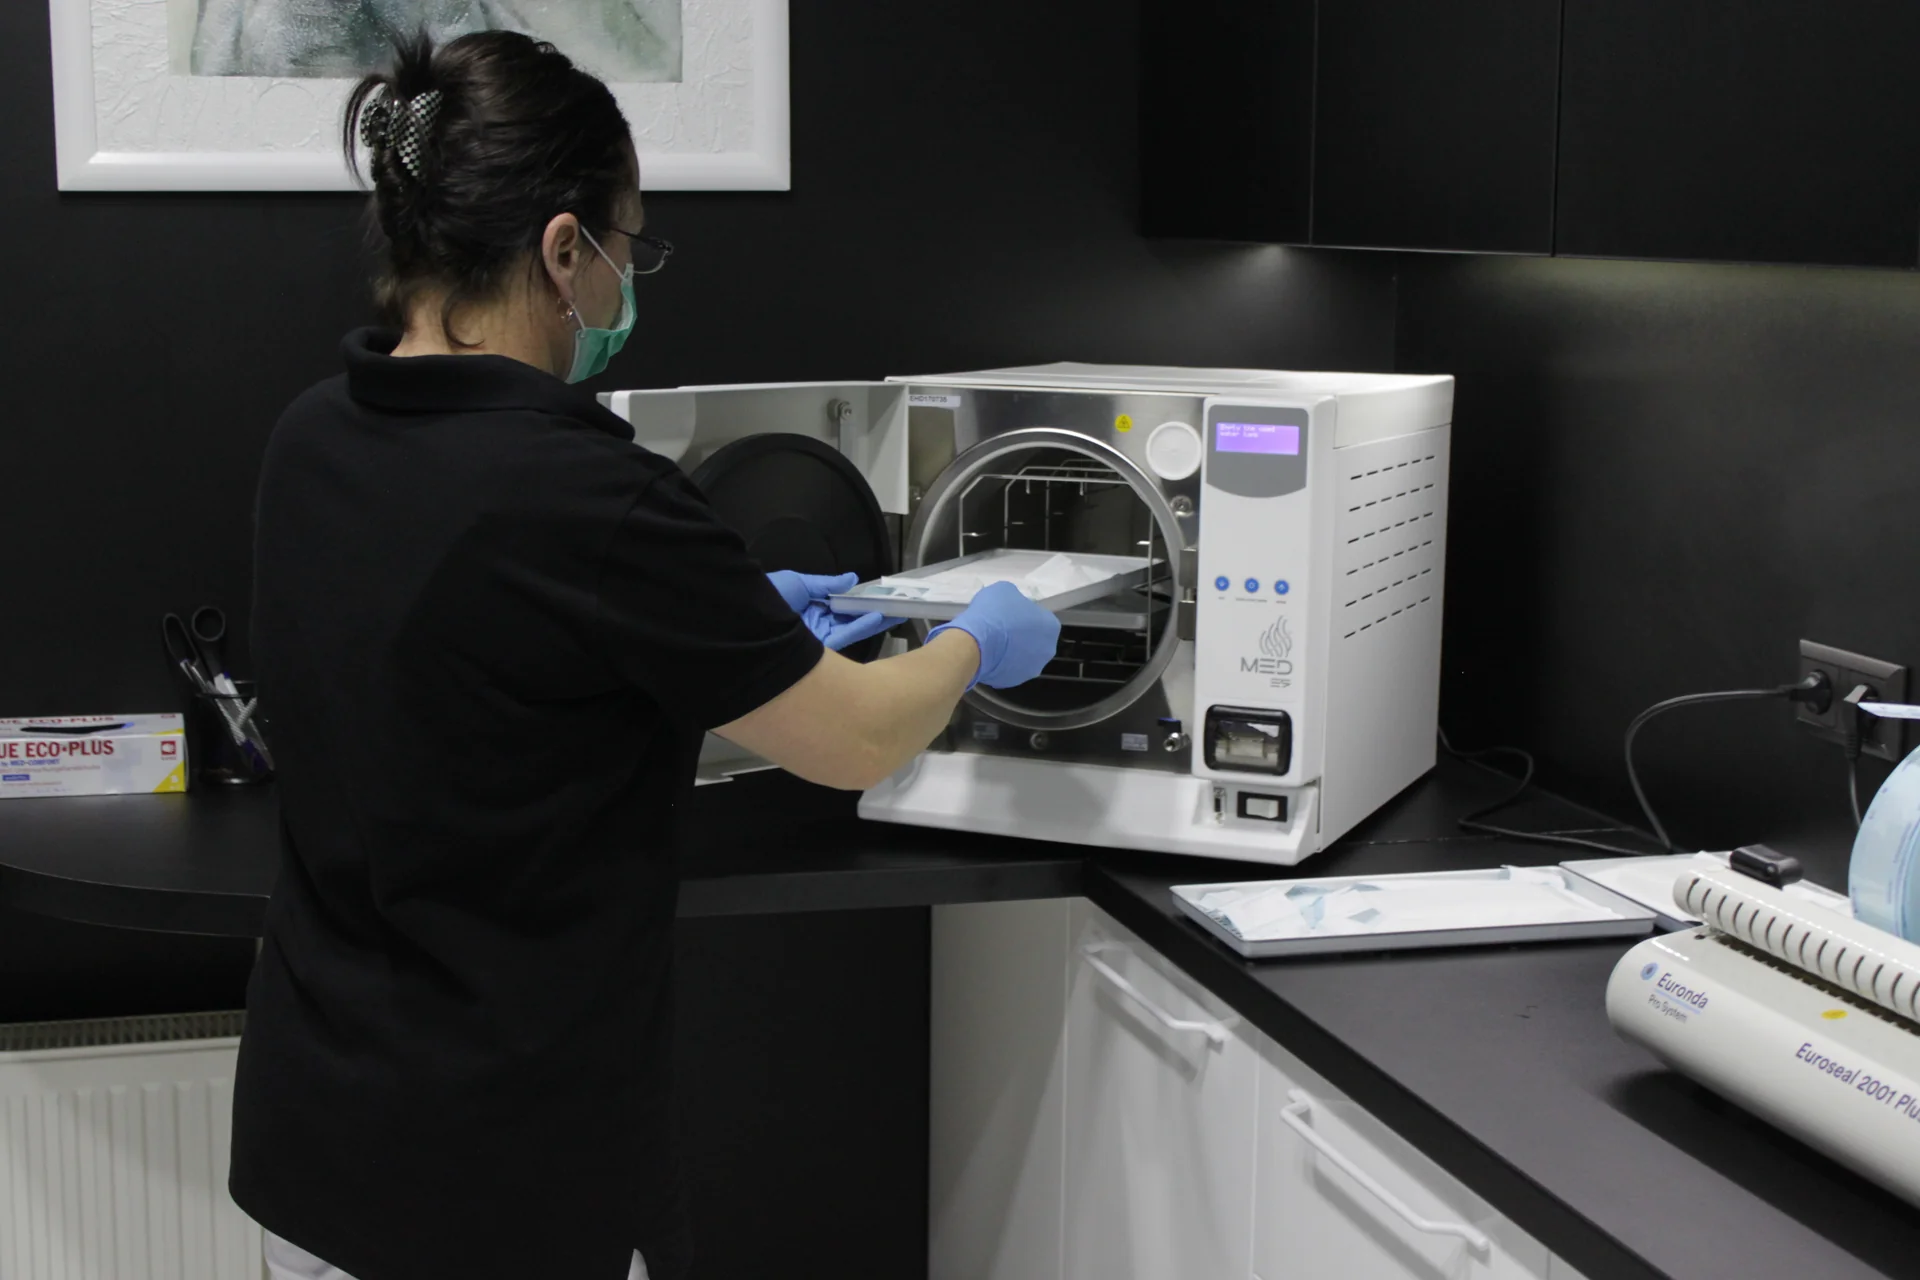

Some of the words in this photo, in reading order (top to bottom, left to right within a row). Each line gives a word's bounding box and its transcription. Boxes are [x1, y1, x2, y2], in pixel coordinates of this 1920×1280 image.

[1240, 657, 1293, 675] MED
[1657, 972, 1709, 1009] Euronda
[1796, 1042, 1862, 1085] Euroseal
[1856, 1075, 1898, 1105] 2001
